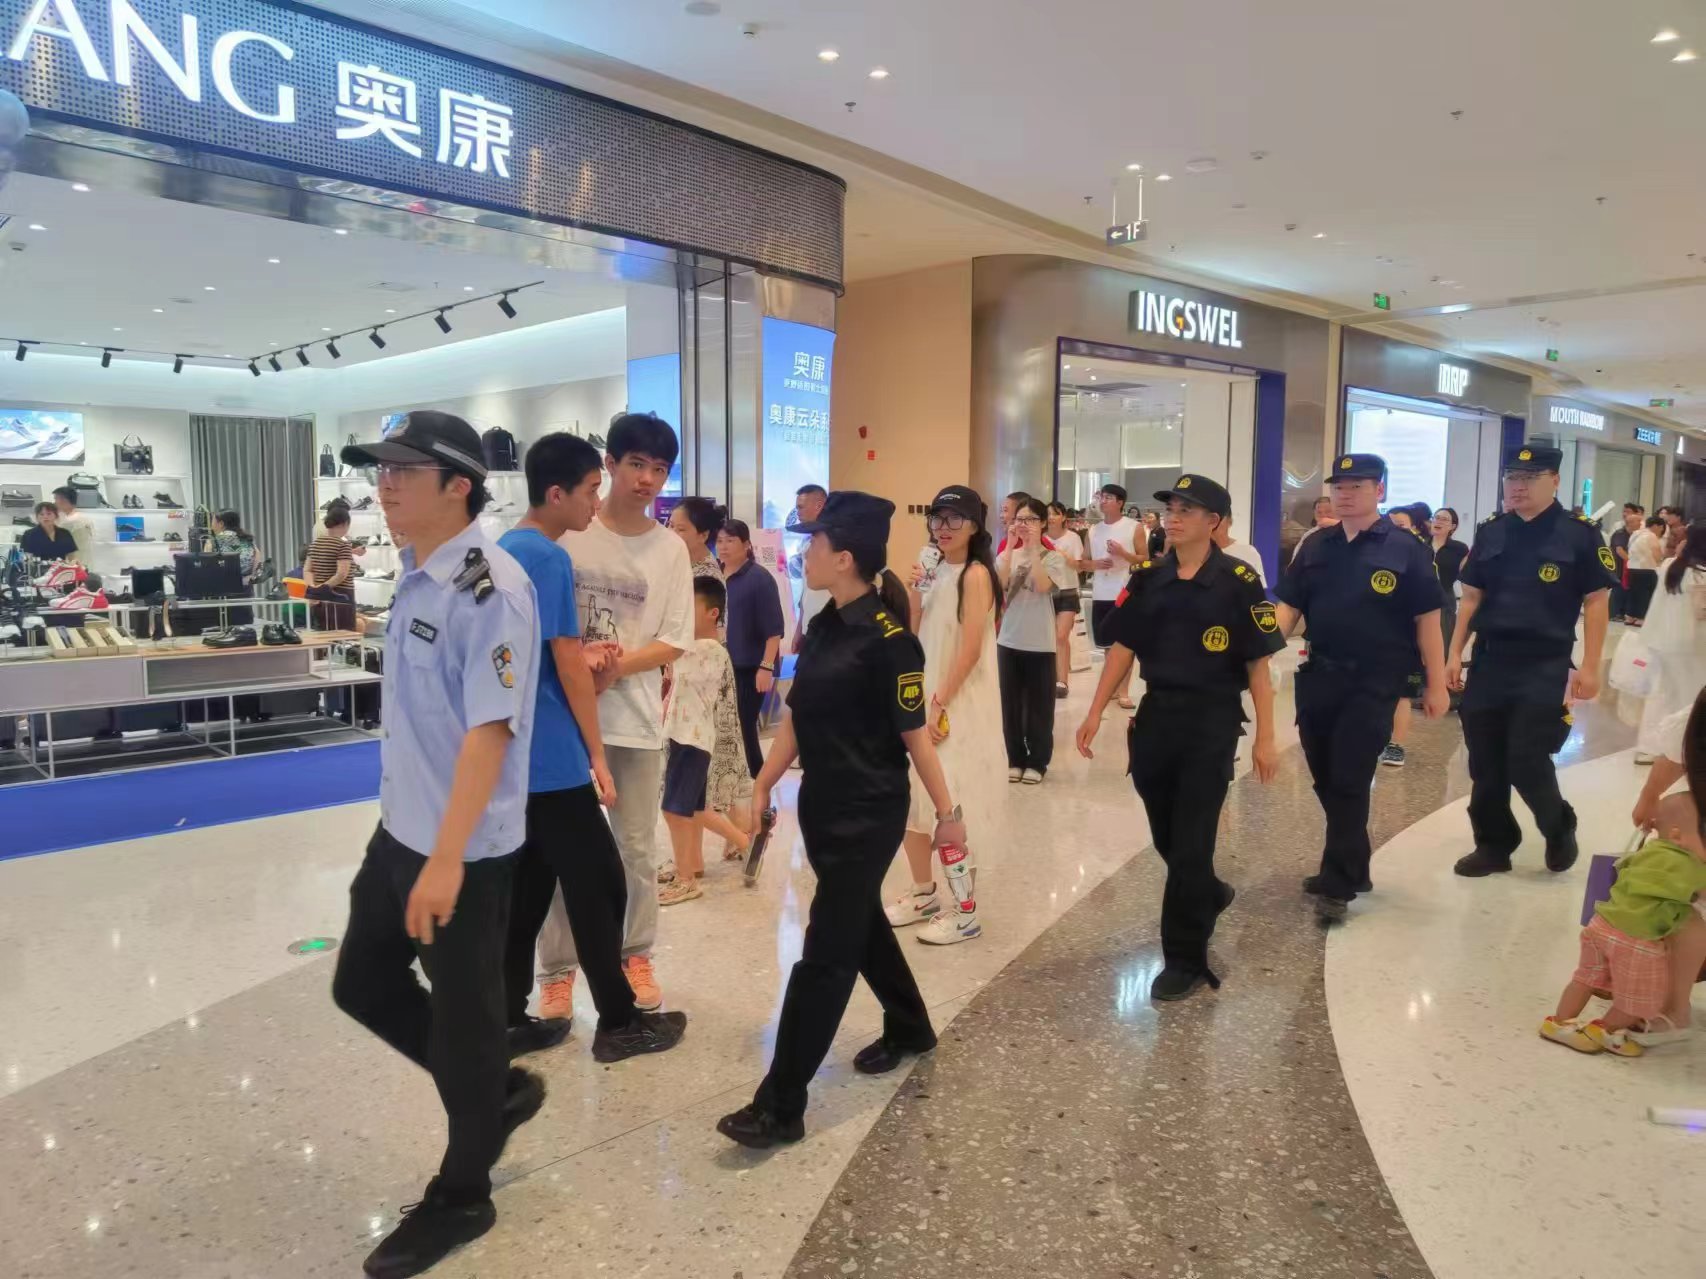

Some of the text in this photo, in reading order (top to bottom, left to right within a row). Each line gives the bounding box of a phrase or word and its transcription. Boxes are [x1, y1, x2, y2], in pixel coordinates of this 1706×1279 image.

[0, 0, 515, 179] ANG 奥康
[1126, 222, 1141, 241] 1F
[793, 351, 825, 381] 奥康
